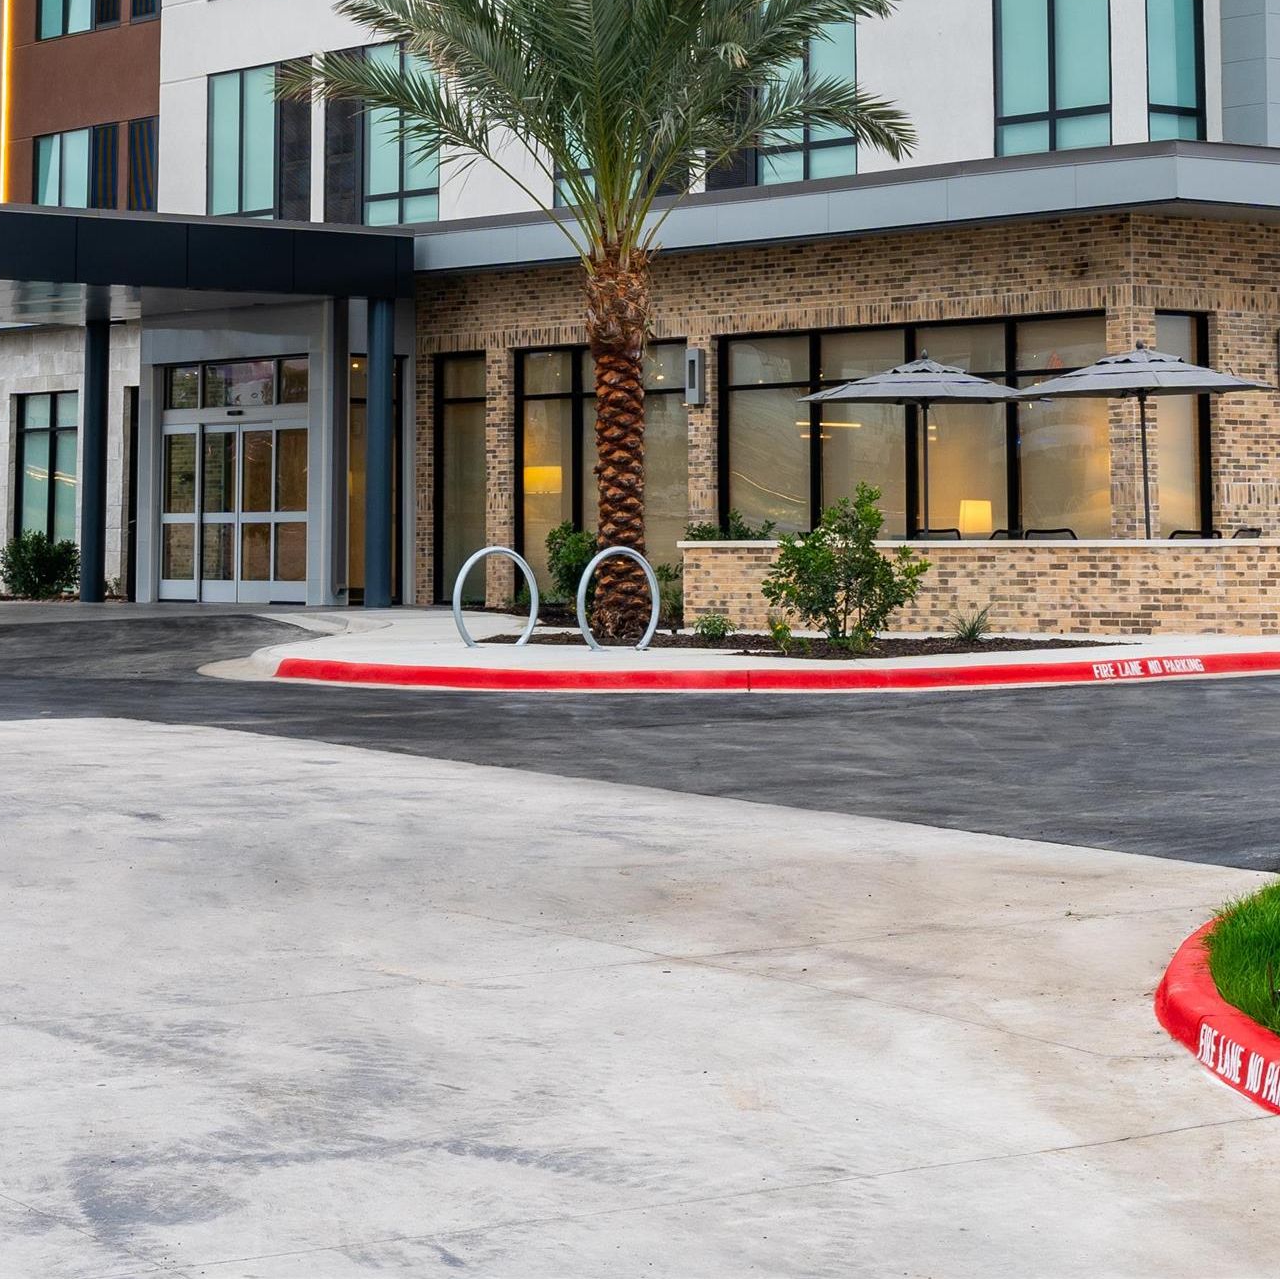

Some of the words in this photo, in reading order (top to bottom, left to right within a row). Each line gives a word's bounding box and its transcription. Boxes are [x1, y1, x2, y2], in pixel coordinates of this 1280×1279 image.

[1092, 663, 1117, 679] FIRE
[1116, 660, 1145, 677] LANE
[1147, 659, 1163, 675] NO
[1163, 658, 1205, 673] PARKING
[1196, 1023, 1219, 1068] FIRE
[1216, 1035, 1245, 1085] LANE
[1244, 1052, 1265, 1094] NO
